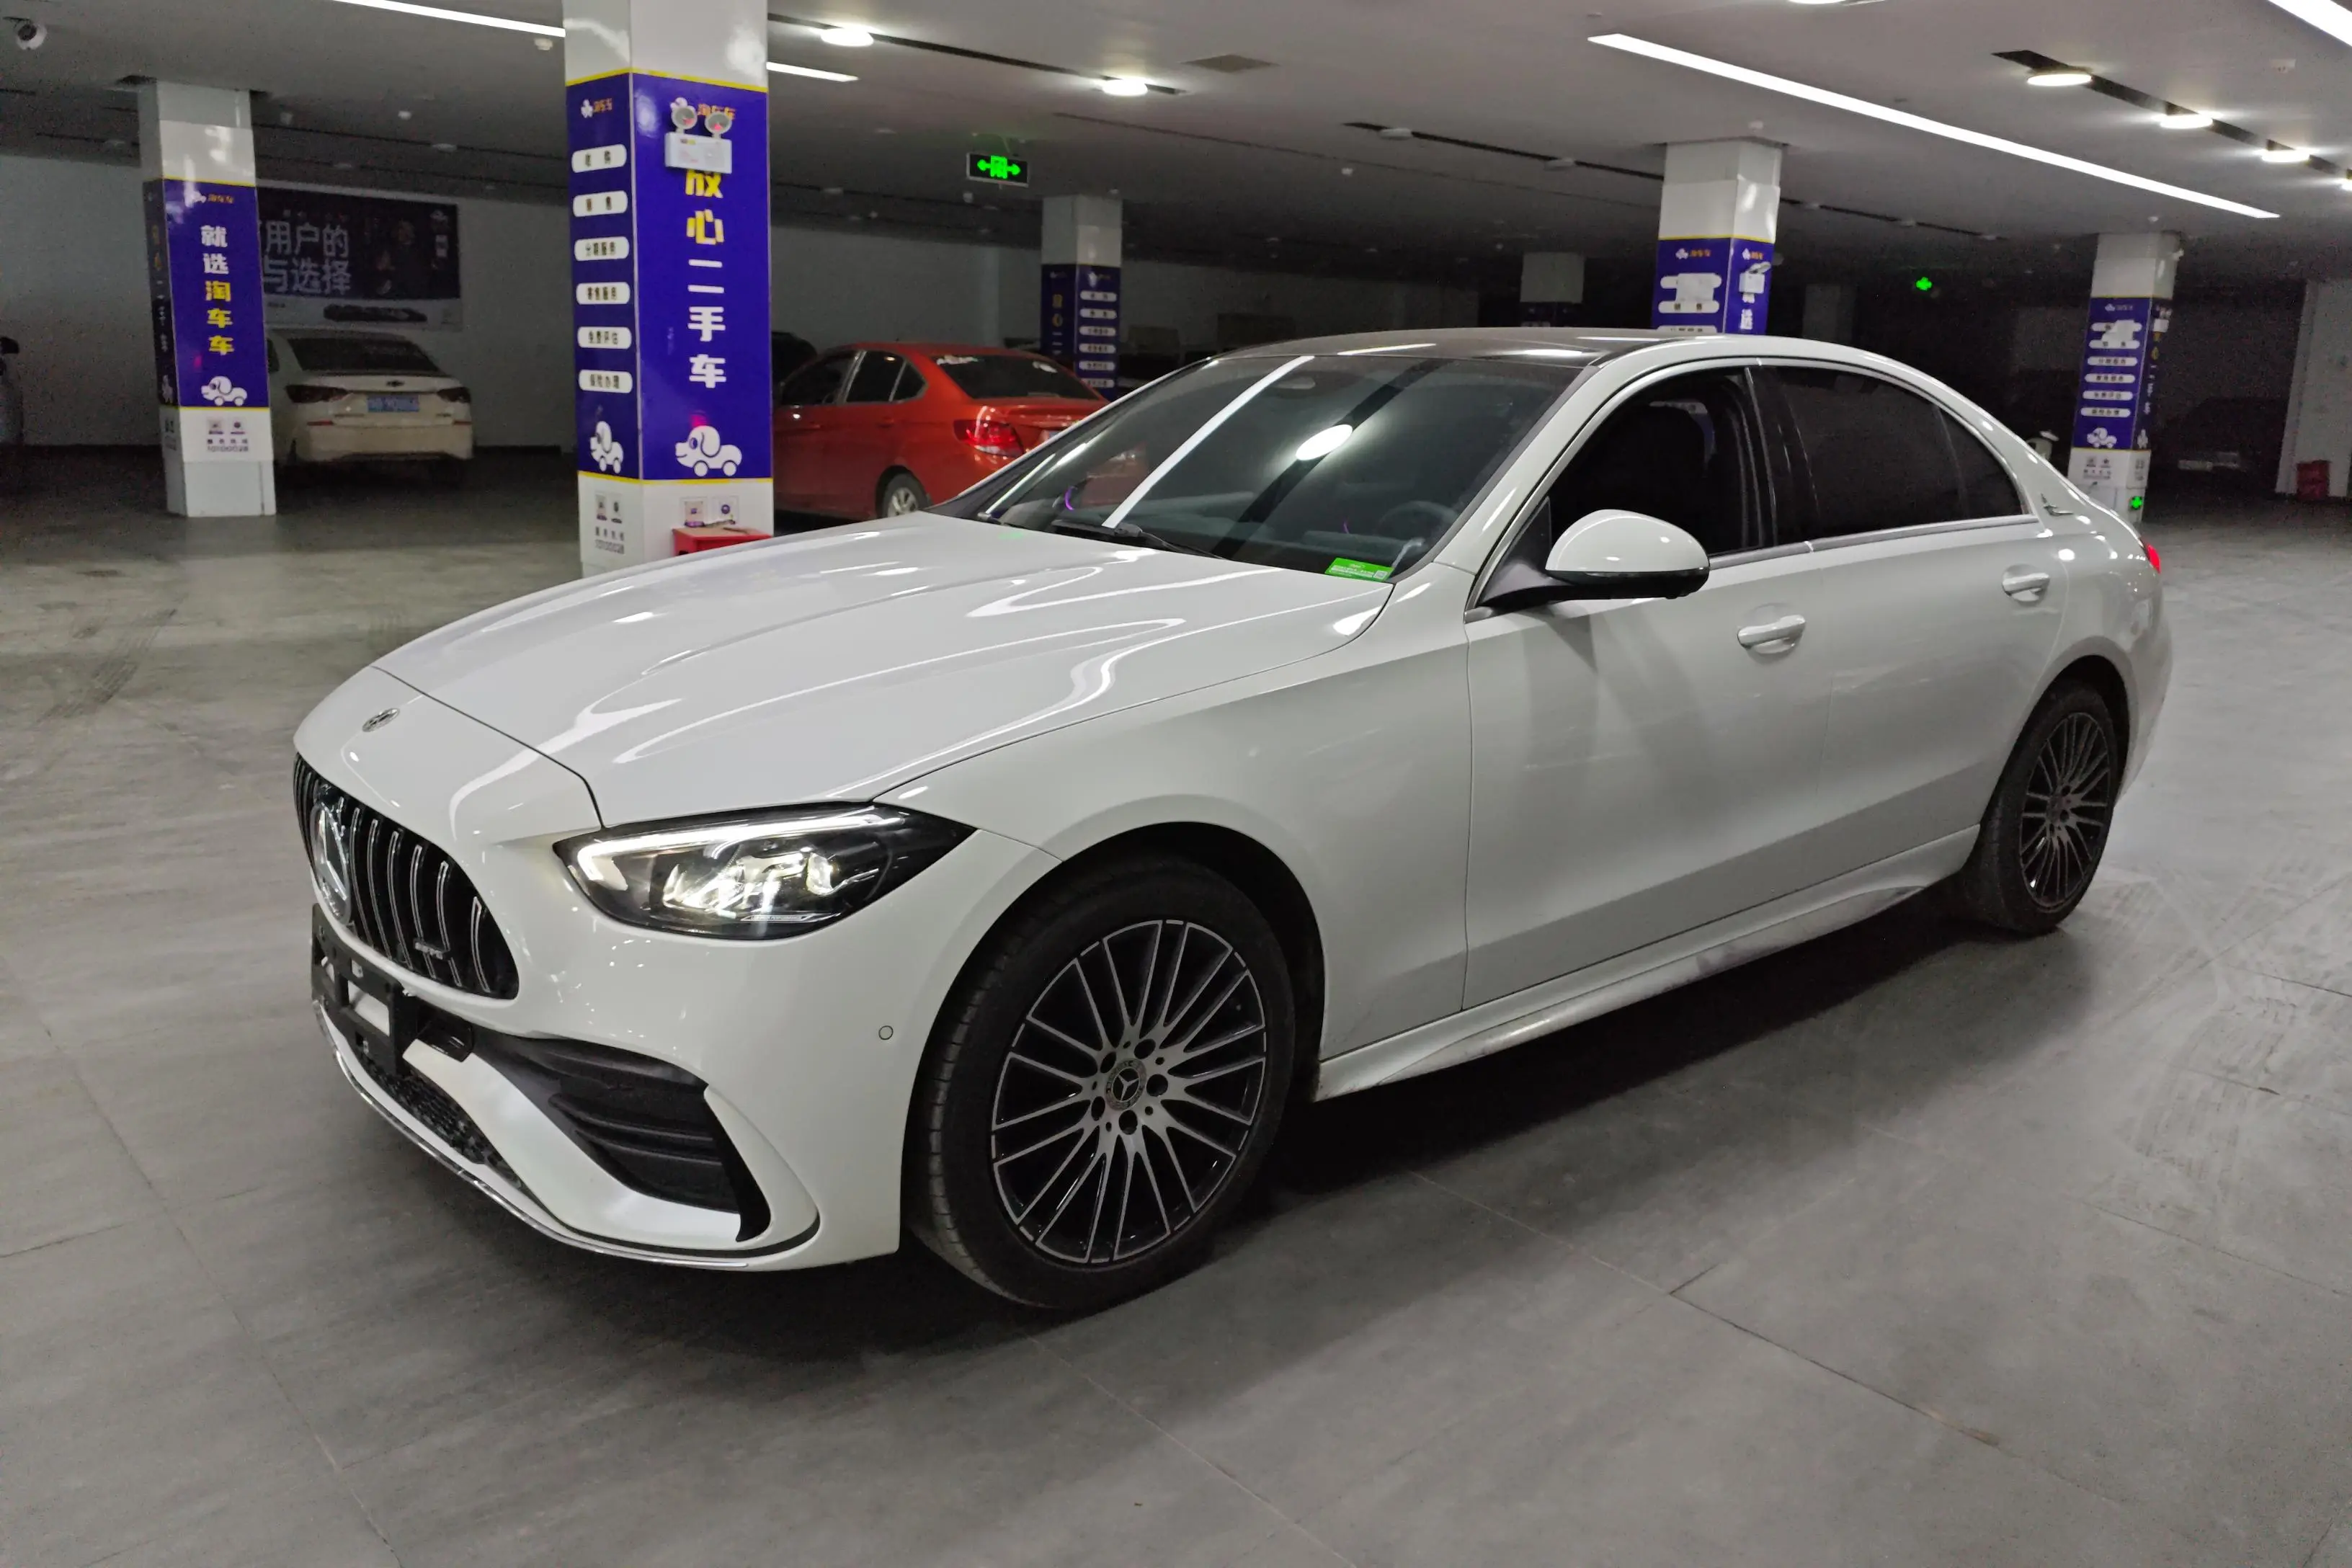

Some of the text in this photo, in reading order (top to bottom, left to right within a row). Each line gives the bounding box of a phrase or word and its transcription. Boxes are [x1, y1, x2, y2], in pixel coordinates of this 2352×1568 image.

[200, 225, 235, 356] 就选淘车车
[262, 255, 352, 295] 与选择
[685, 169, 727, 389] 放心二手车
